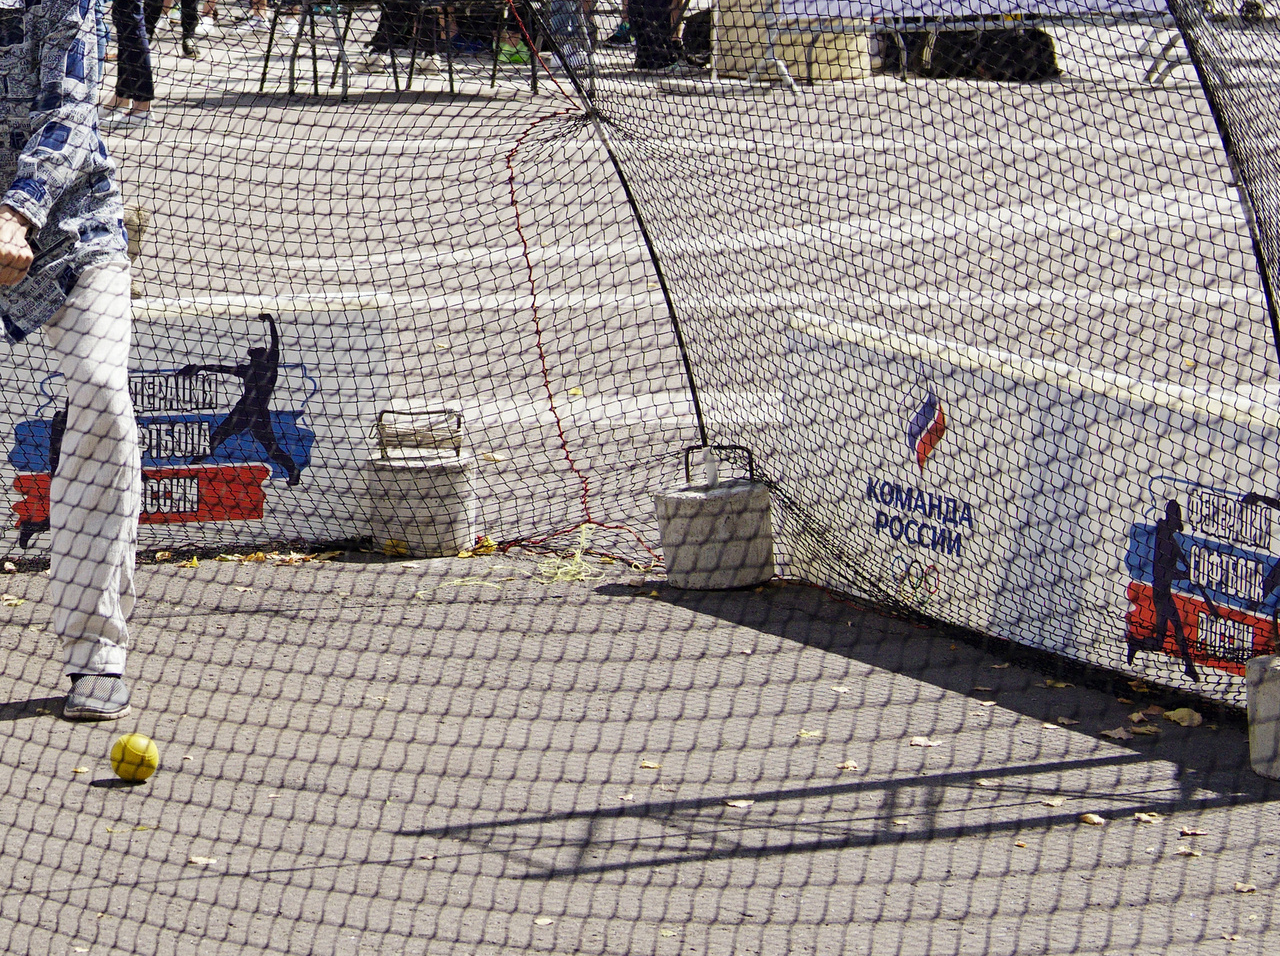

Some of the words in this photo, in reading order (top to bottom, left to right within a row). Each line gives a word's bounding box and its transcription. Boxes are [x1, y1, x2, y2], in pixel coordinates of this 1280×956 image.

[129, 374, 218, 412] ДЕРАЦИЯ
[140, 477, 200, 515] ССИИ
[866, 476, 974, 529] КОМАНДА
[1187, 489, 1271, 551] ФЕДЕРАЦИЯ
[875, 509, 962, 557] РОССИИ
[1190, 545, 1264, 603] СОФТБОЛА
